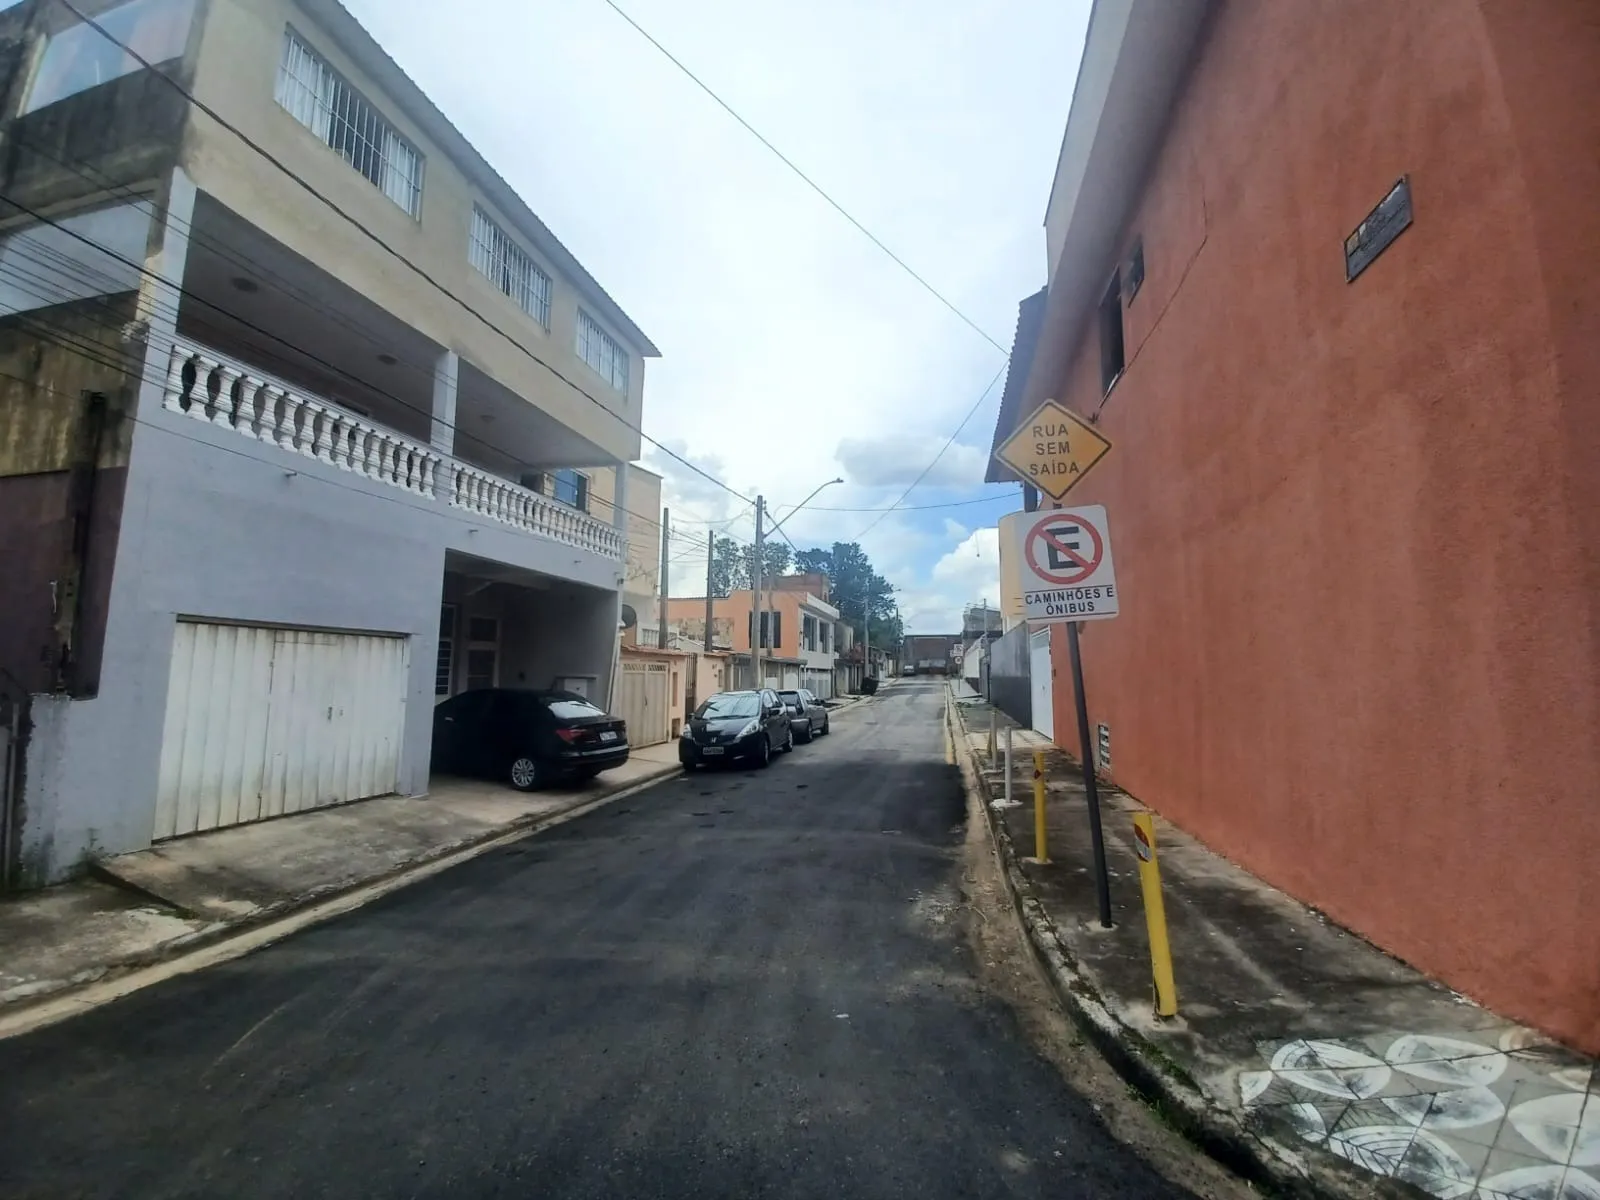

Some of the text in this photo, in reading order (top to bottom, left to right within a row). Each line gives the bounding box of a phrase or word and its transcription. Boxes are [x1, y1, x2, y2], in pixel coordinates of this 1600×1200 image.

[1032, 423, 1069, 438] RUA
[1035, 441, 1070, 456] SEM
[1029, 459, 1080, 476] SAÍDA
[1024, 587, 1114, 605] CAMINHÕES E
